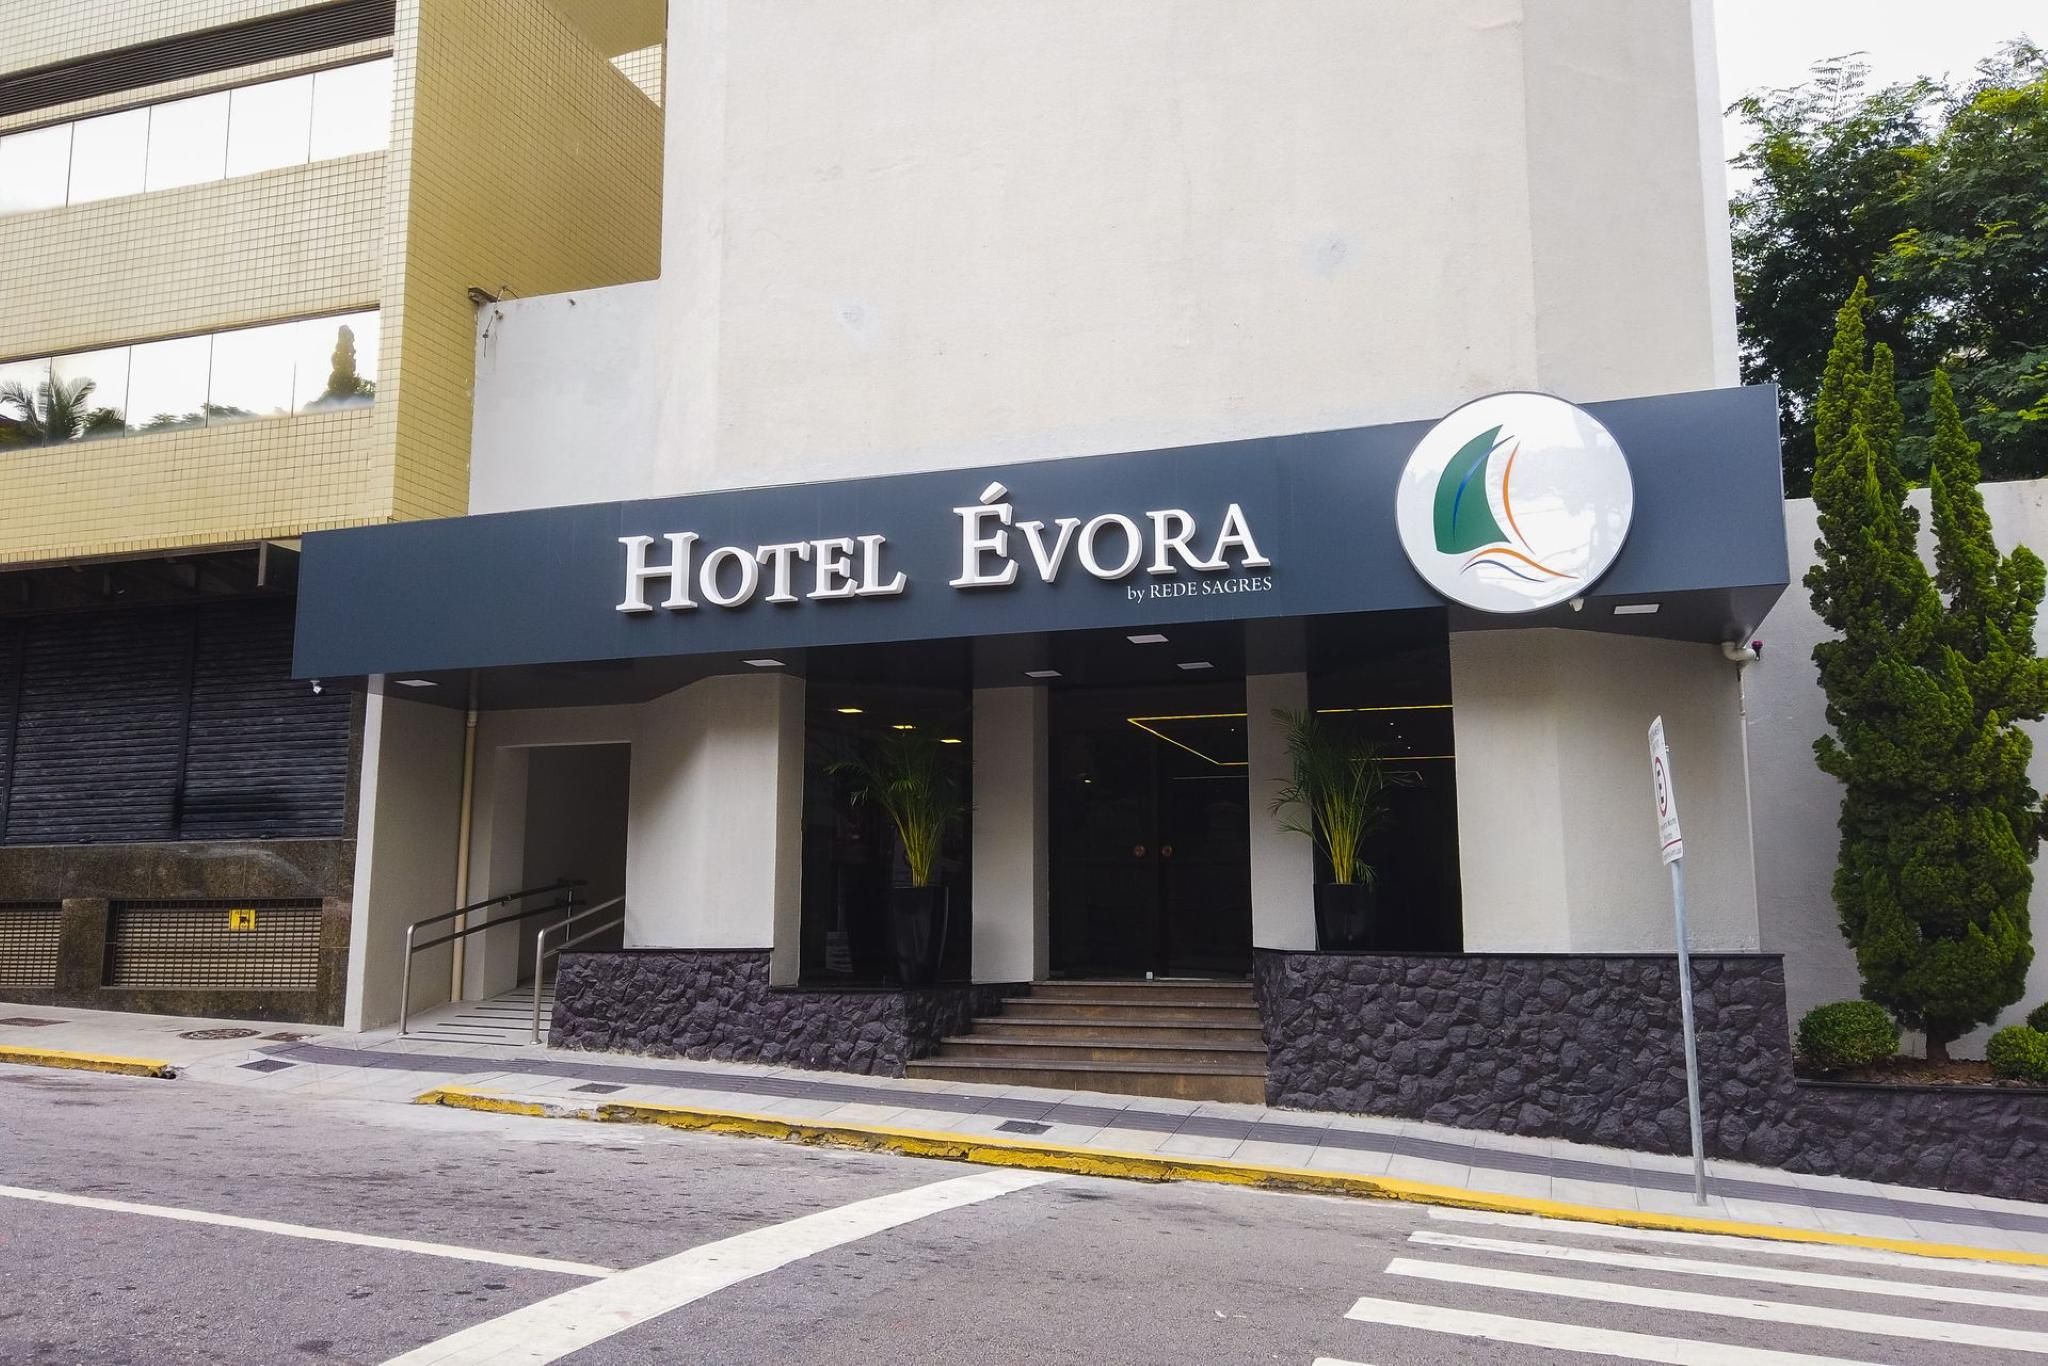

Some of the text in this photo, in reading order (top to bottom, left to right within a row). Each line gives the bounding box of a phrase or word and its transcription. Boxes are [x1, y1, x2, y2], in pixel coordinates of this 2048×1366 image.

[616, 481, 1270, 613] HOTEL ÉVORA
[1127, 576, 1272, 604] by REDE SAGRES
